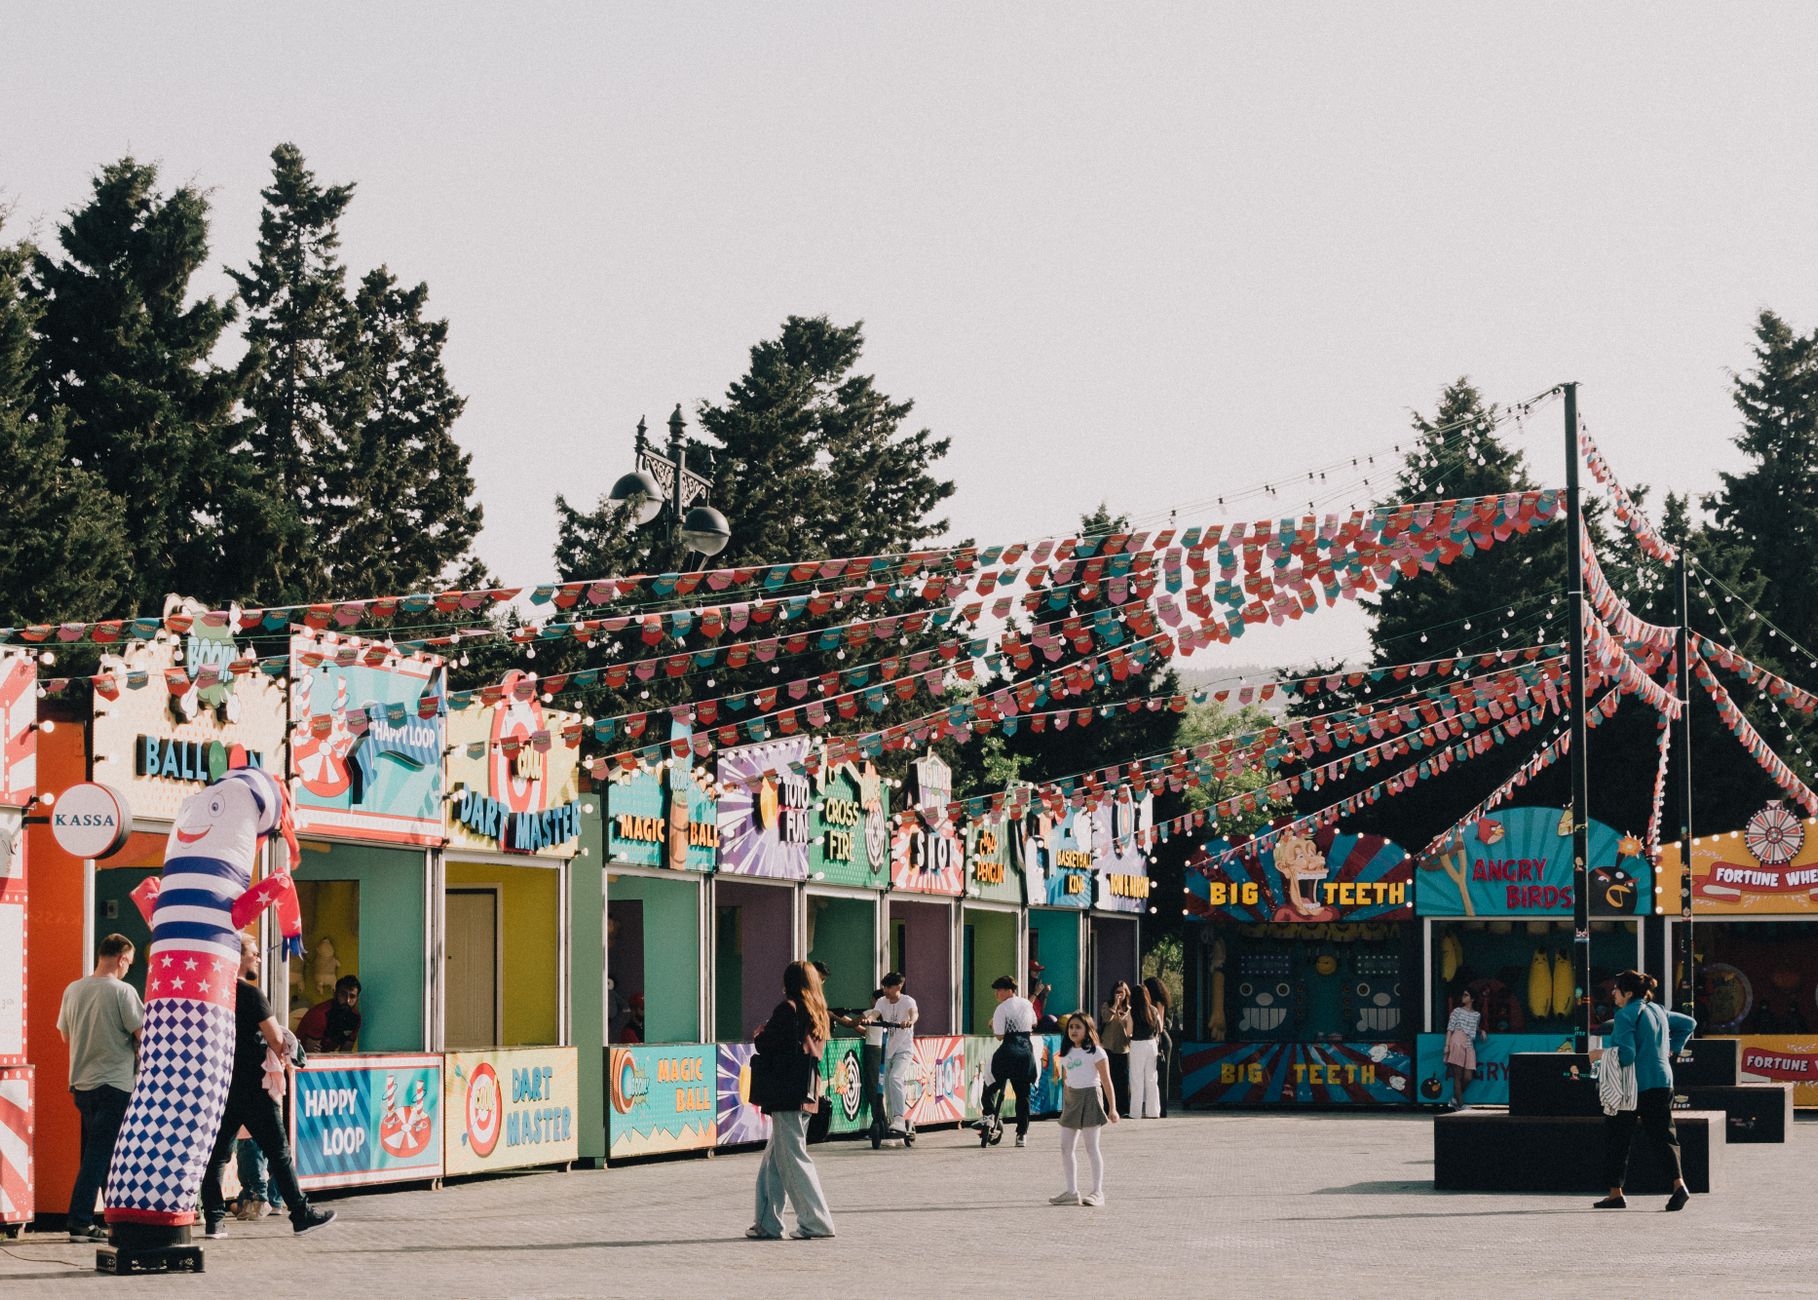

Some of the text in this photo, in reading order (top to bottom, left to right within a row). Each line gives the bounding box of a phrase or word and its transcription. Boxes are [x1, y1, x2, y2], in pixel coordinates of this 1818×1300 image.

[373, 719, 408, 745] HAPPY
[409, 724, 436, 748] LOOP
[784, 778, 810, 809] TOTO
[55, 814, 114, 827] KASSA
[461, 782, 582, 850] DART MASTER
[826, 797, 859, 826] CROSS
[621, 815, 720, 848] MAGIC BALL
[786, 811, 809, 842] FUN
[830, 830, 855, 861] FIRE
[977, 861, 1005, 883] PENGUIN
[1472, 858, 1547, 882] ANGRY
[1716, 867, 1779, 887] FORTUNE
[1210, 882, 1405, 905] BIG TEETH
[1506, 885, 1573, 909] BIRDS
[657, 1056, 703, 1083] MAGIC
[1221, 1063, 1375, 1084] BIG TEETH
[1747, 1055, 1808, 1072] FORTUNE
[512, 1066, 553, 1103] DART
[305, 1088, 358, 1117] HAPPY
[676, 1086, 711, 1113] BALL
[507, 1106, 571, 1146] MASTER
[323, 1127, 365, 1156] LOOP
